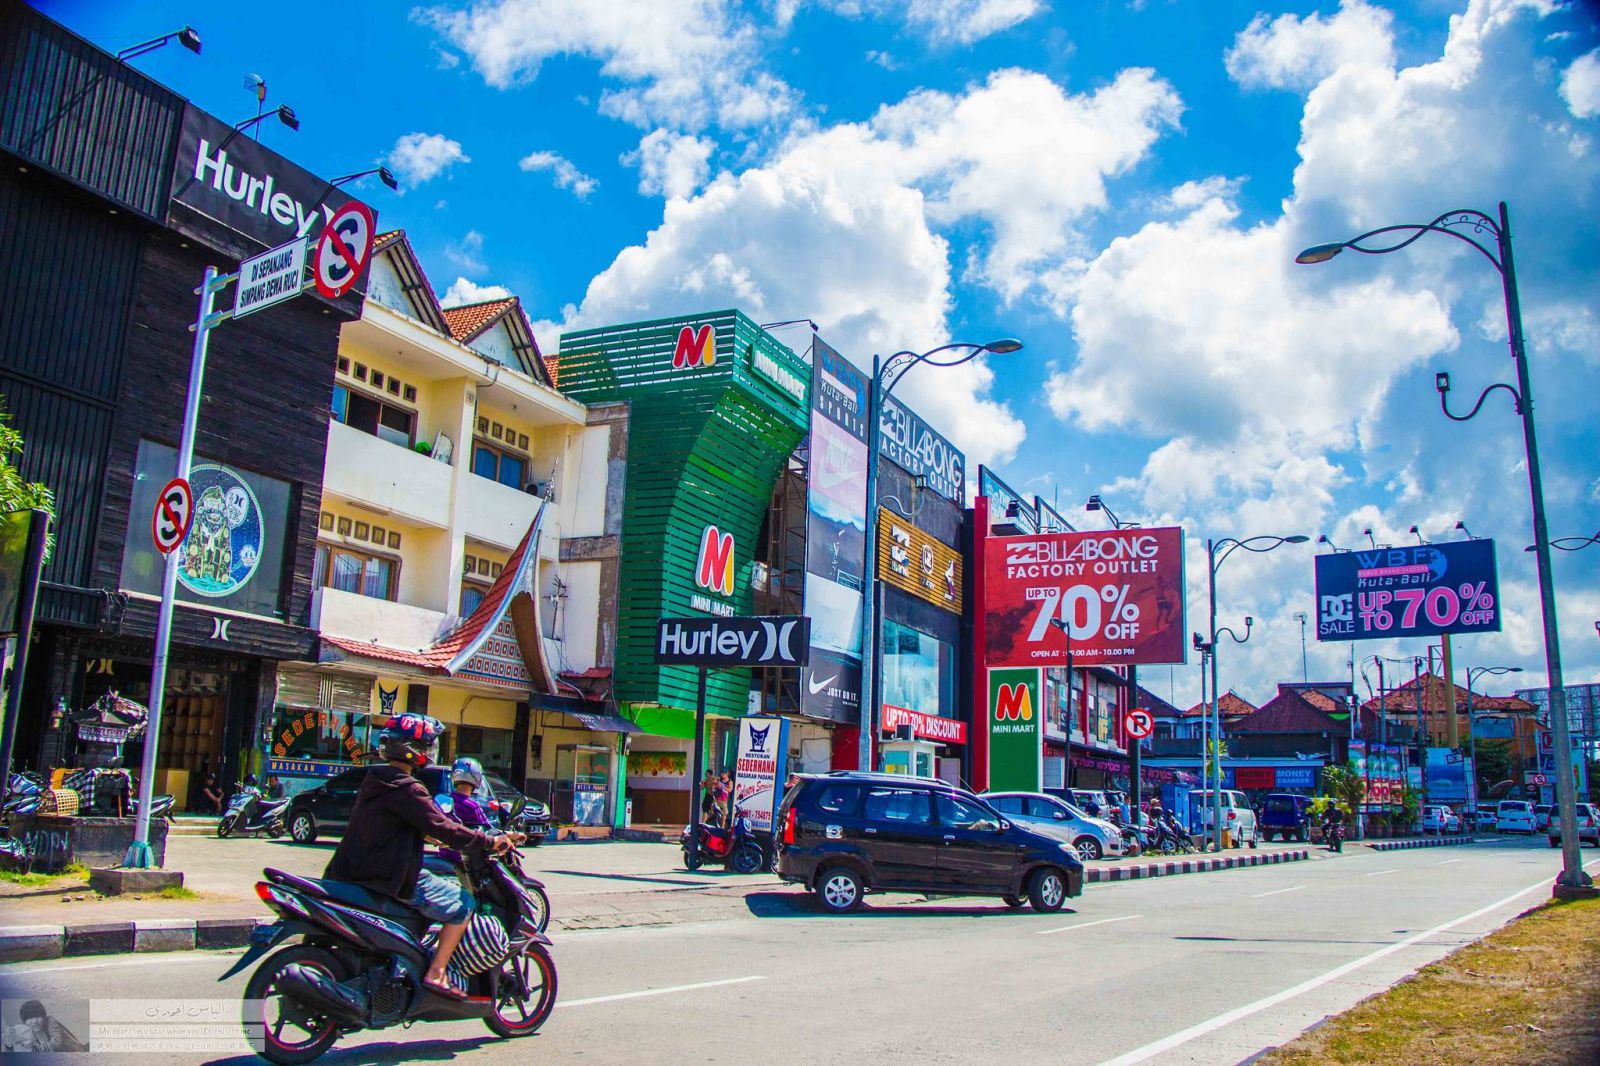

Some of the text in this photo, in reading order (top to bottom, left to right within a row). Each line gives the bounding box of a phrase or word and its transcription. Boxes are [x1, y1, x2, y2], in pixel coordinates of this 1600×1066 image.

[195, 138, 318, 239] Hurley
[251, 249, 293, 282] DI SEPANJANG
[240, 269, 299, 308] SIMPANG DEWA RUCI
[819, 396, 864, 437] SPORTS
[896, 407, 962, 488] BILLABONG
[881, 436, 924, 475] ACTORY
[929, 470, 963, 504] OUTLET
[1036, 536, 1159, 563] BILLABONG
[1356, 549, 1427, 569] WBF
[1007, 560, 1158, 579] FACTORY OUTLET
[1357, 572, 1431, 588] Kuta-Bali
[1027, 588, 1056, 598] UP TO
[1358, 591, 1392, 612] UP
[1395, 581, 1494, 628] 70%
[691, 594, 735, 618] MINI MART
[1026, 584, 1140, 642] 70%
[1103, 623, 1140, 640] OFF
[1319, 610, 1494, 635] SALE TO OFF
[660, 623, 760, 659] Hurley
[1031, 650, 1050, 658] OPEN
[1103, 648, 1122, 656] 10.00
[826, 686, 842, 698] JUST
[842, 690, 850, 700] DO
[886, 707, 960, 741] UP TO 70% DISCOUNT
[992, 724, 1034, 733] MINI MART
[1133, 715, 1147, 733] P
[271, 761, 315, 772] MASAKAN
[737, 758, 775, 774] SEDERHANA
[1277, 769, 1311, 778] MONEY
